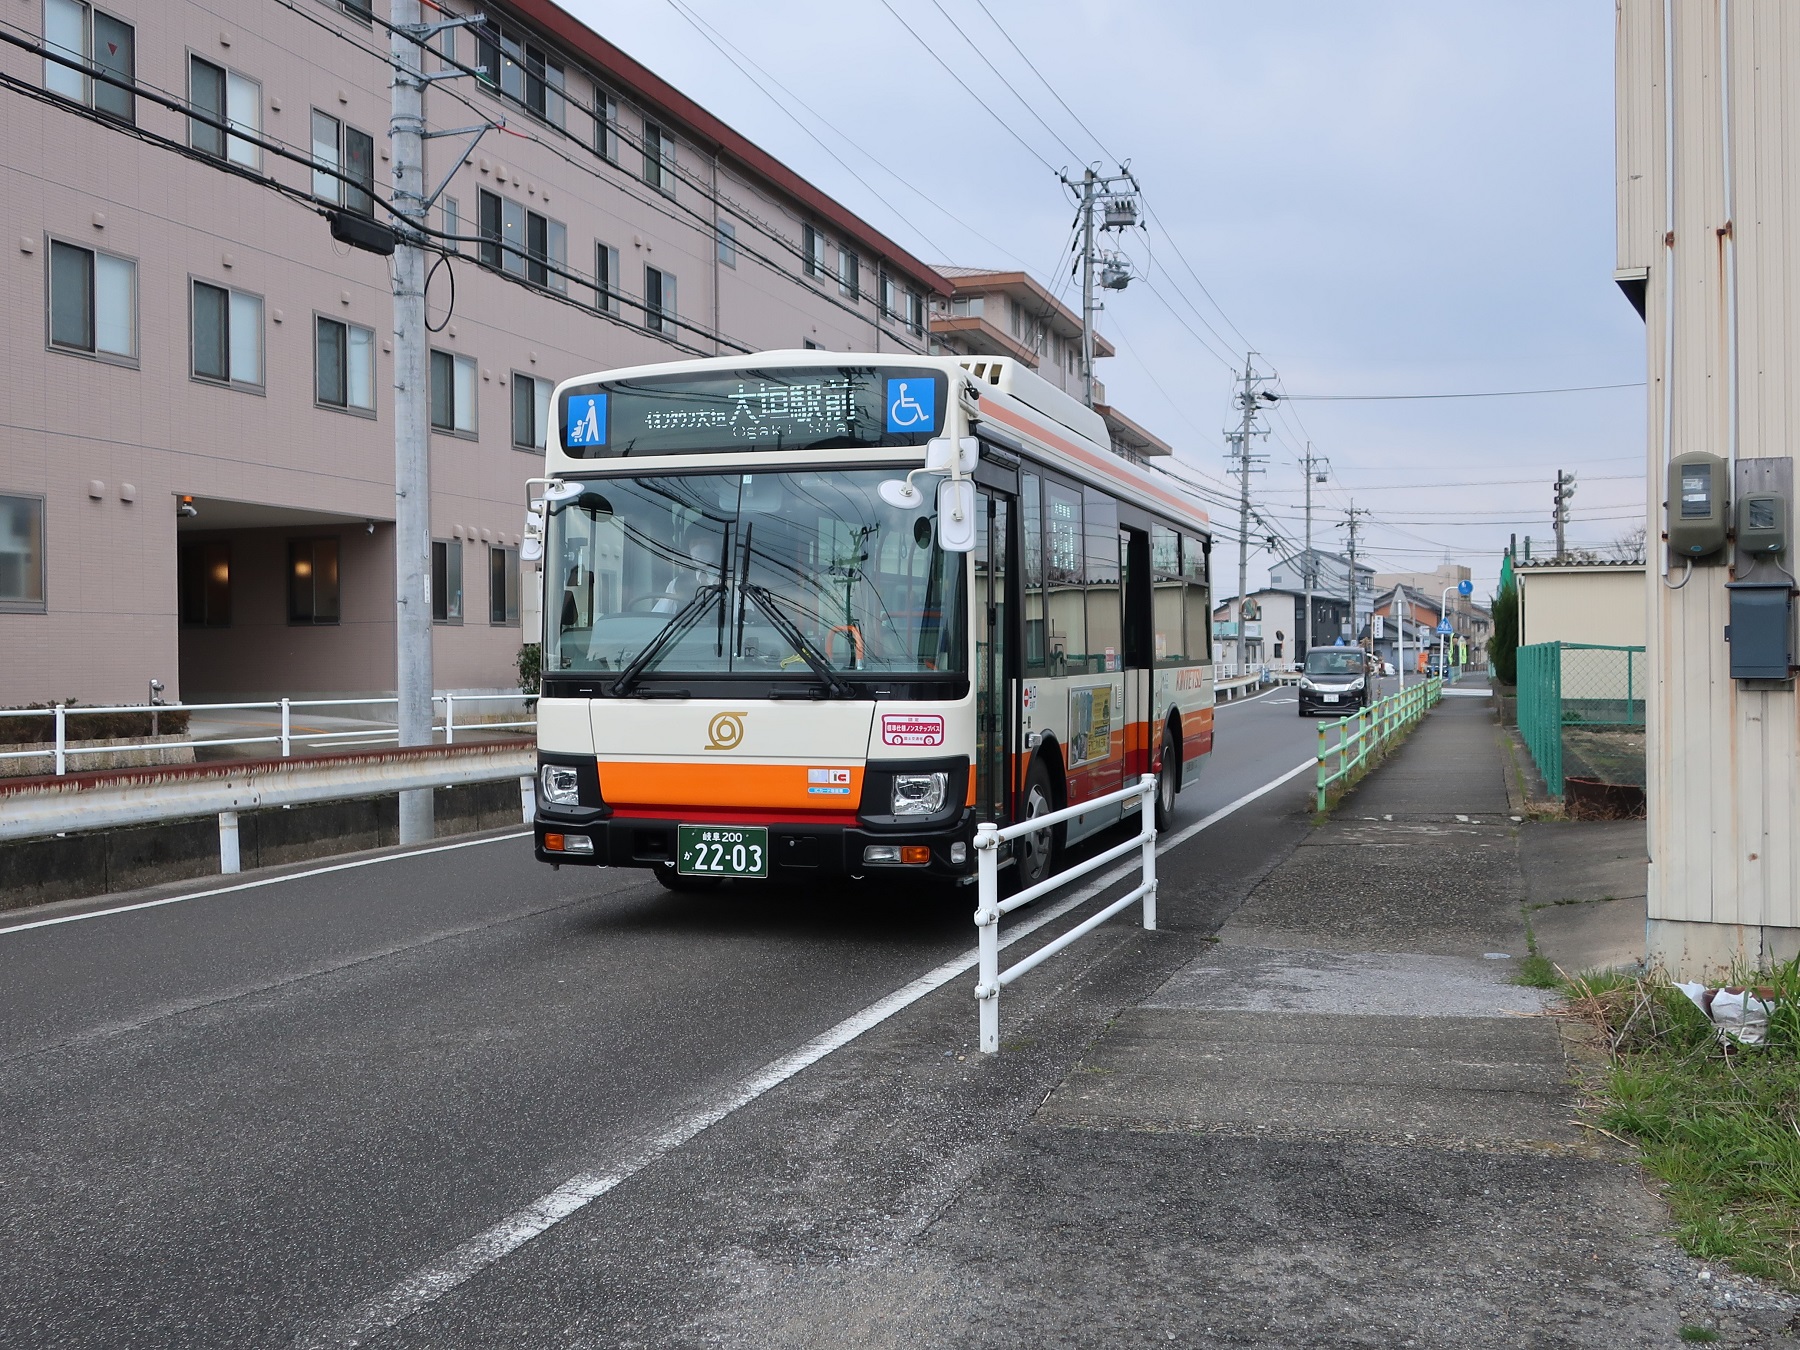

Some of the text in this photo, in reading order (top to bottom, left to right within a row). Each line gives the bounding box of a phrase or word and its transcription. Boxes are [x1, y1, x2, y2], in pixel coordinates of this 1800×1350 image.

[727, 378, 856, 426] 大垣駅前
[732, 424, 792, 439] Ogaki
[683, 843, 763, 873] か 22-03
